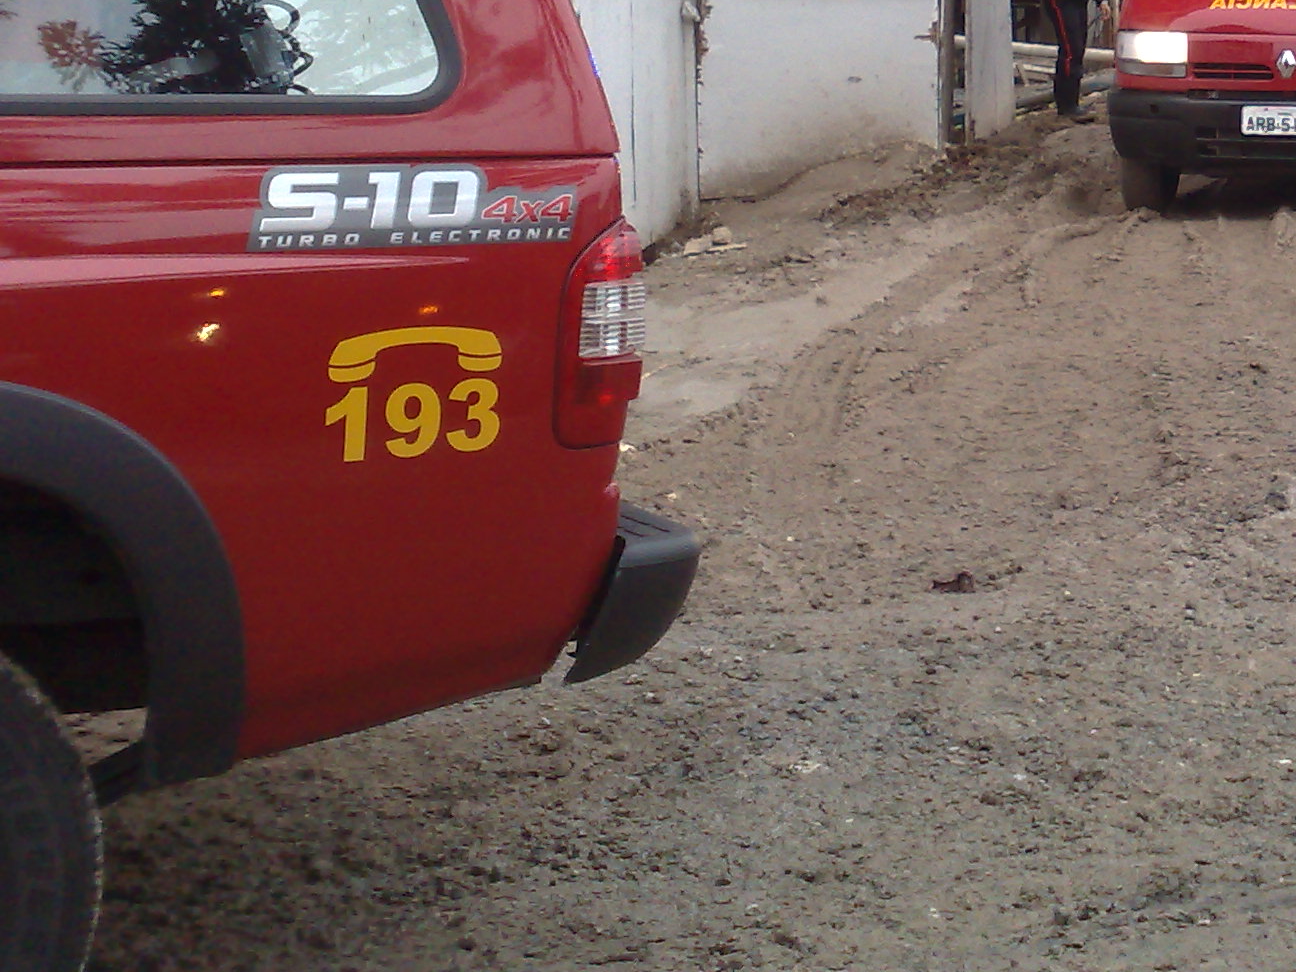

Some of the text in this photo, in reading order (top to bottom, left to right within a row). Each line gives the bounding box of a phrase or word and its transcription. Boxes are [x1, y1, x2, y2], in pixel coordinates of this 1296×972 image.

[259, 170, 574, 233] S-10 4x4
[258, 227, 571, 249] TURBO ELECTRONIC
[324, 377, 501, 463] 193
